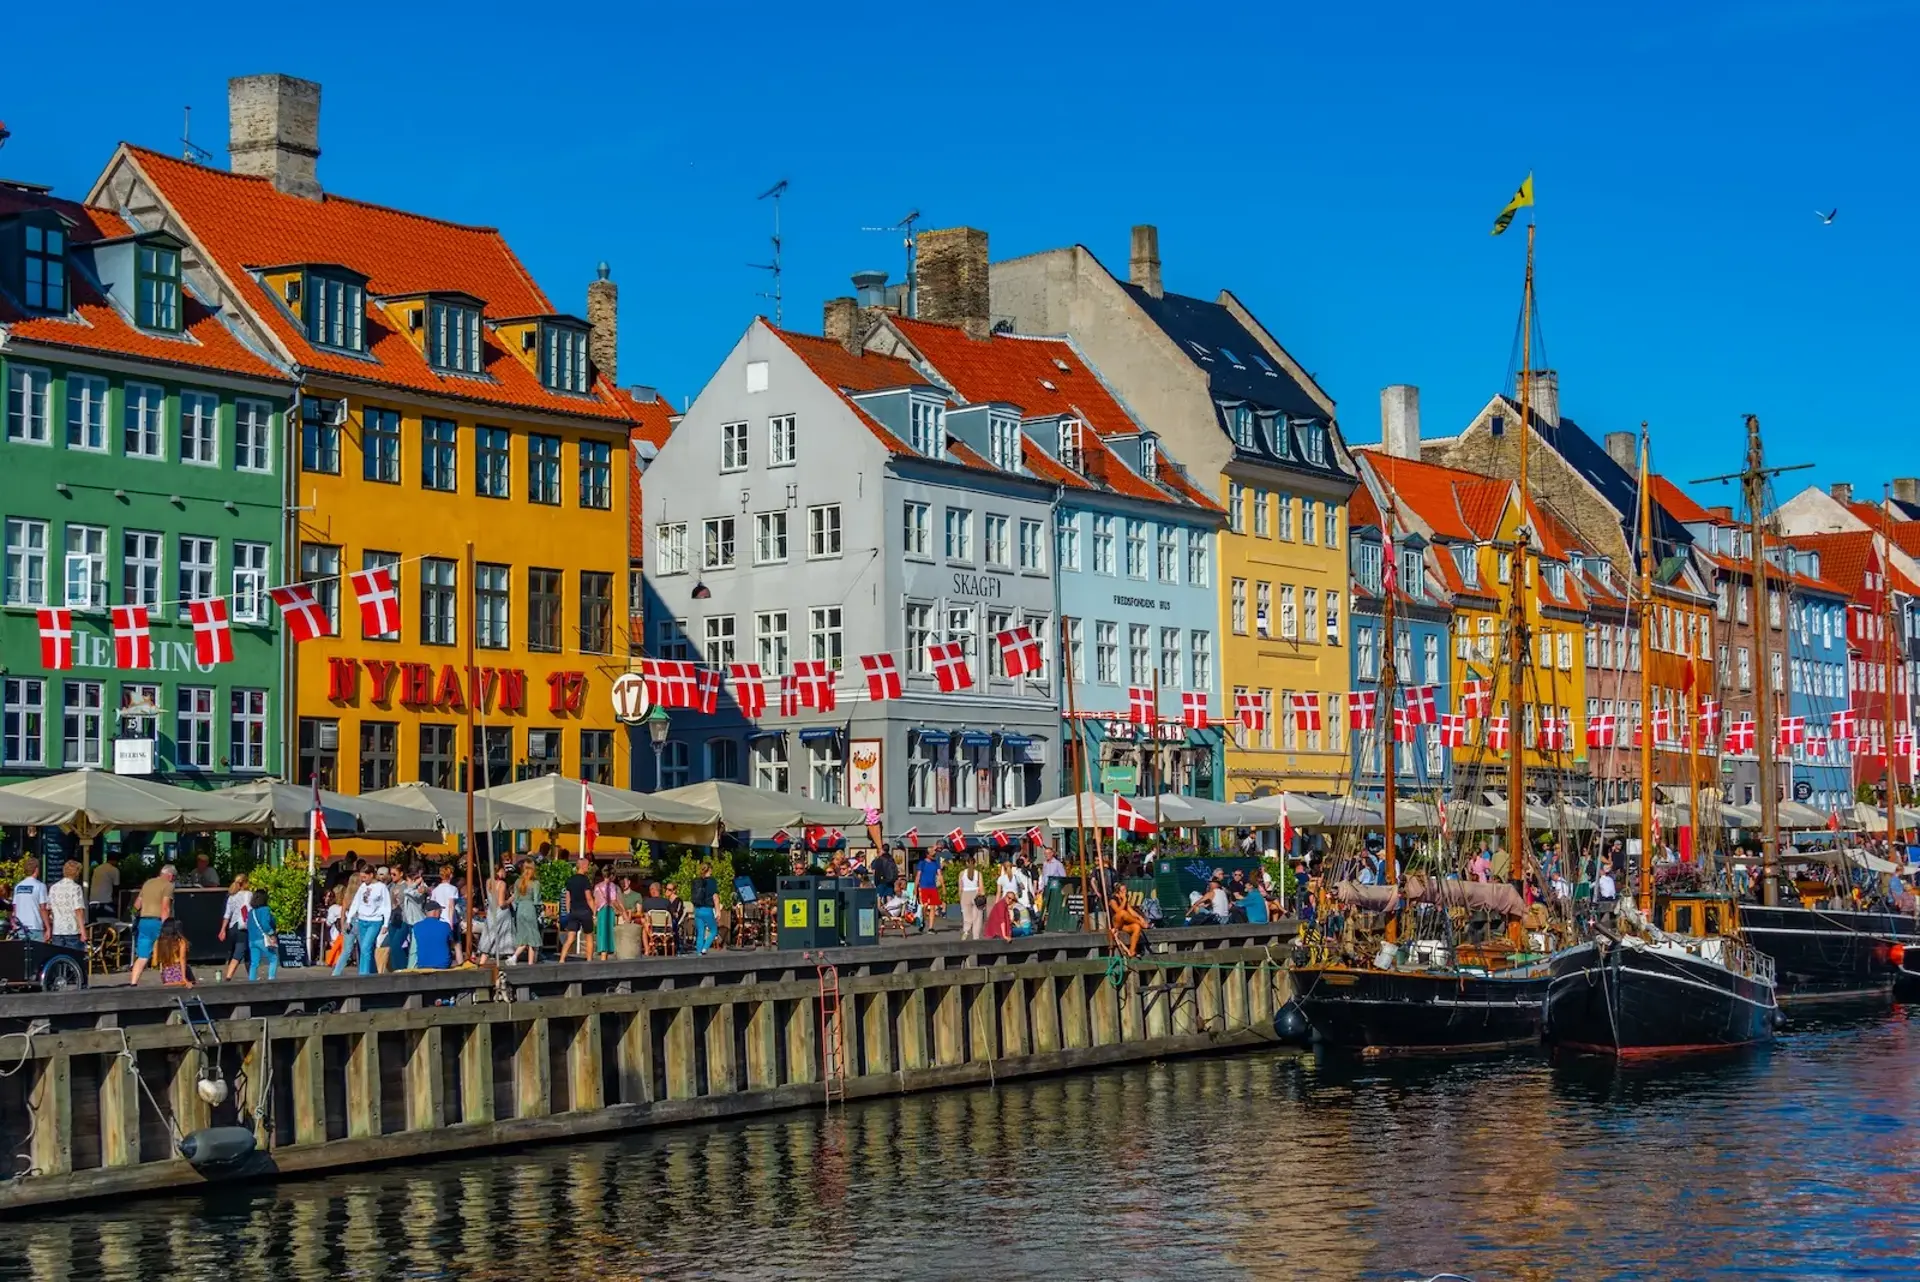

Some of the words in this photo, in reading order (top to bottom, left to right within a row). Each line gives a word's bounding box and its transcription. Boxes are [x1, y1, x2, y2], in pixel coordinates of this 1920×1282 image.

[327, 656, 526, 712] NYHAVN
[546, 670, 586, 712] 17
[614, 680, 643, 717] 17
